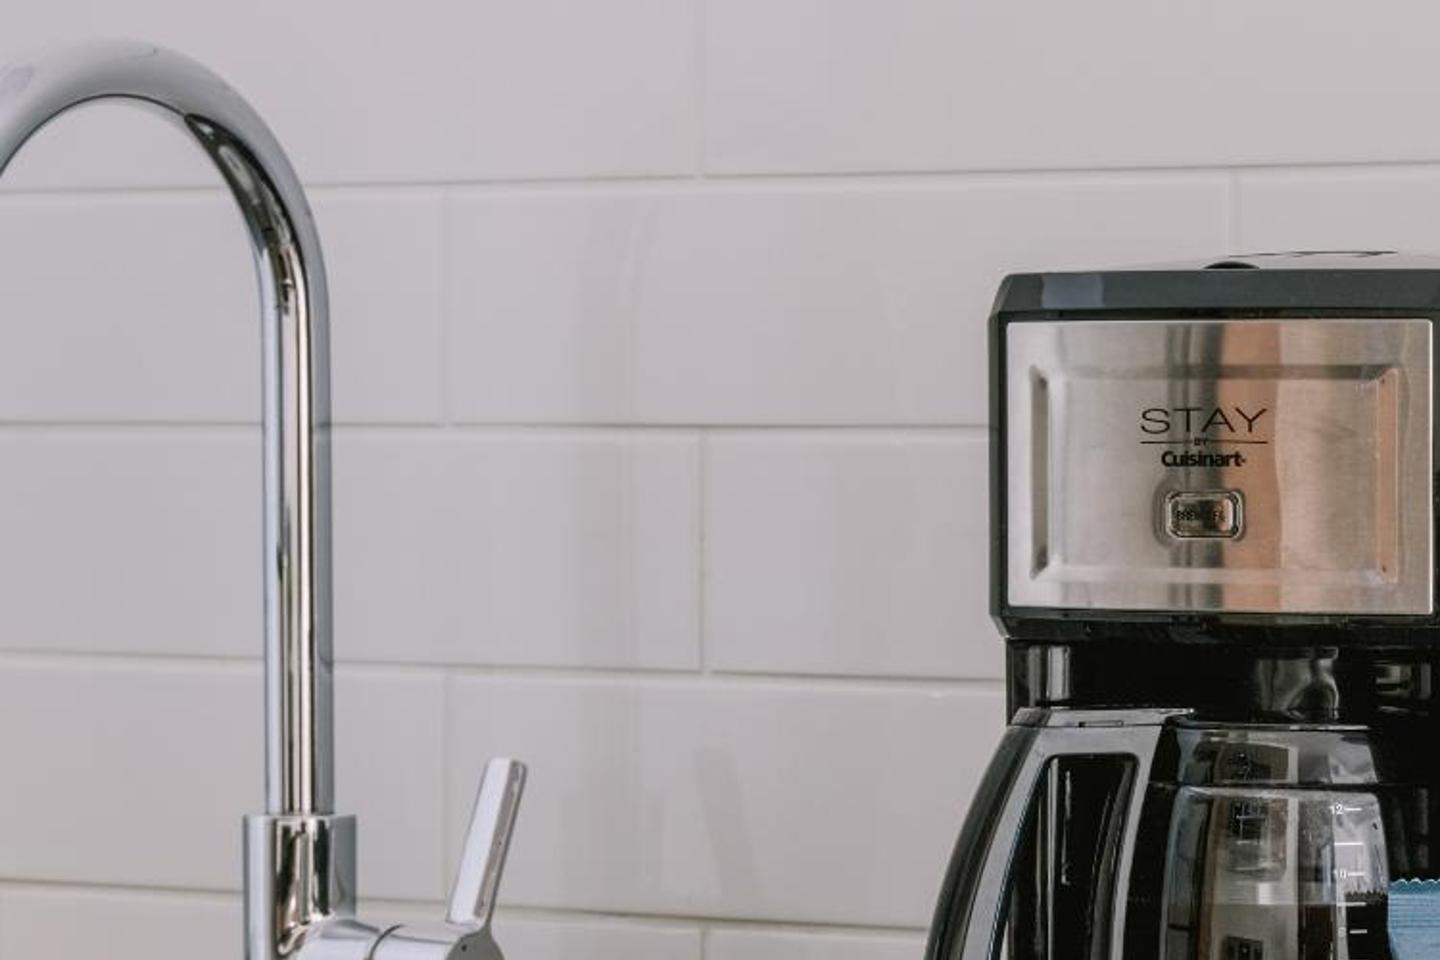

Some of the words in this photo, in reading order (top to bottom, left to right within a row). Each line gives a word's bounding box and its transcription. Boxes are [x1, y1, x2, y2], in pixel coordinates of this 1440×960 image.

[1140, 407, 1268, 434] STAY
[1161, 450, 1243, 468] Cuisinart
[1329, 805, 1345, 816] 12
